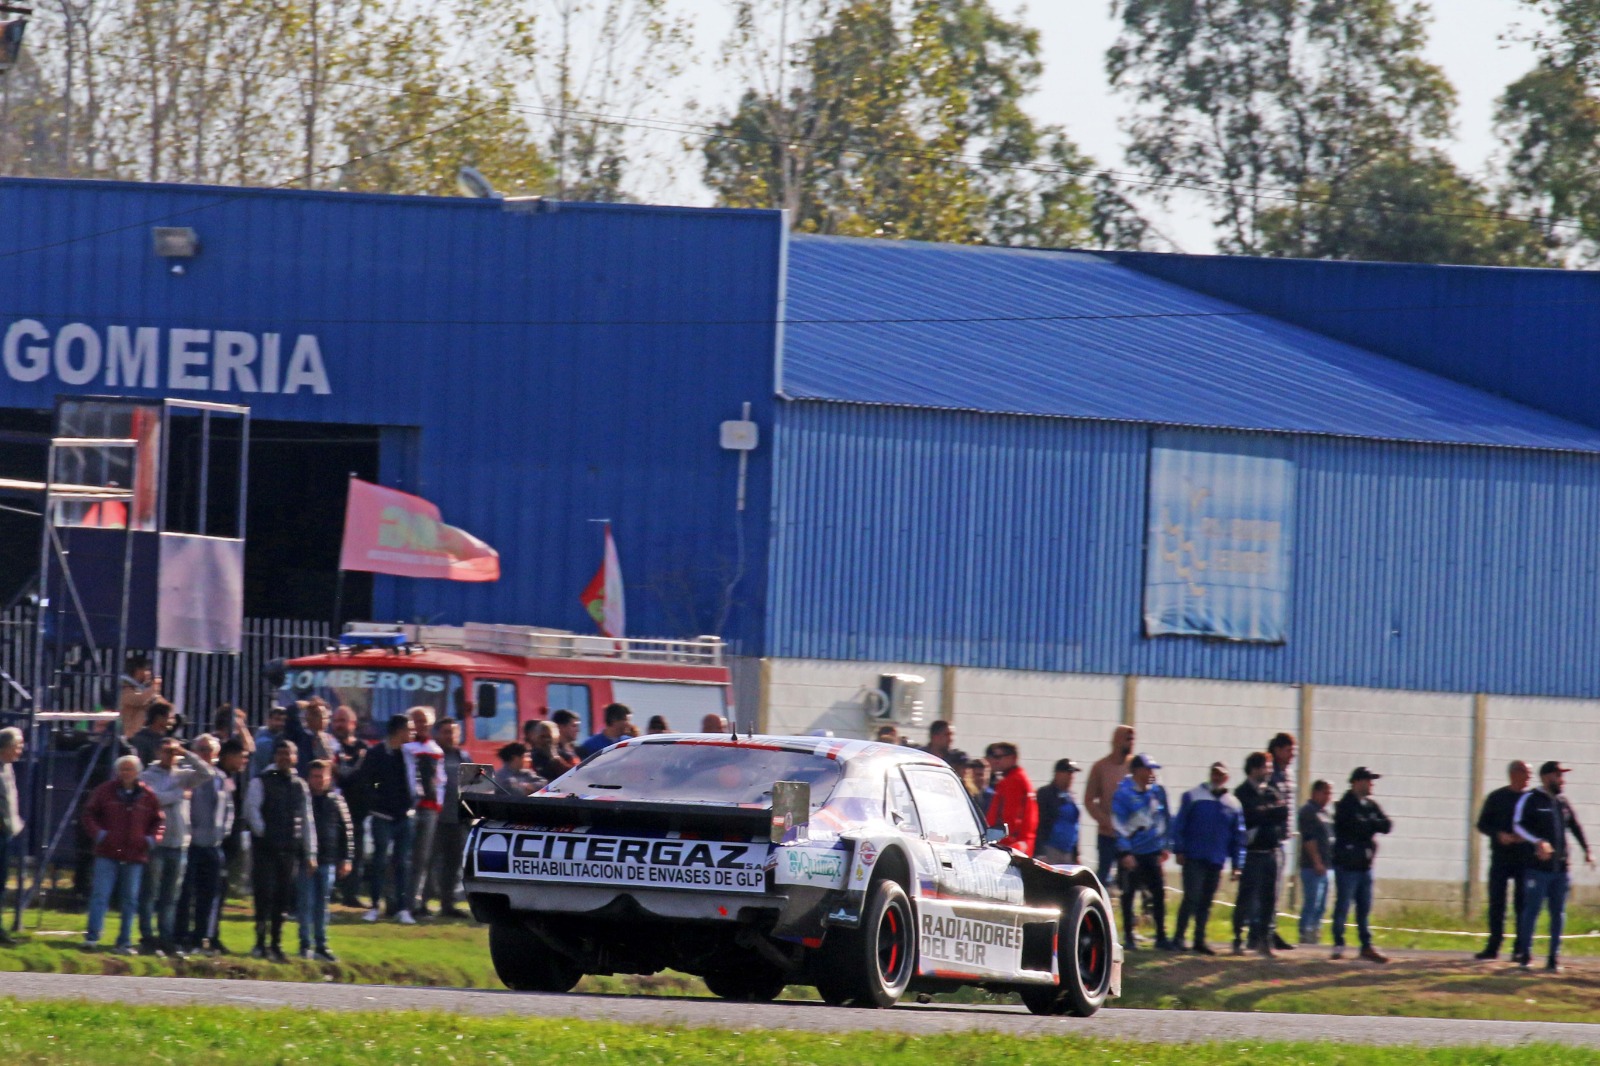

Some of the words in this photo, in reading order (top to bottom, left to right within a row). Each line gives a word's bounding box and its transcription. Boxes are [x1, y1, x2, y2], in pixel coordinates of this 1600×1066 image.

[3, 318, 332, 395] GOMERIA
[512, 833, 749, 870] CITERGAZ
[513, 859, 623, 880] REHABILITACION
[627, 865, 645, 881] DE
[649, 867, 711, 884] ENVASES
[715, 871, 732, 886] DE
[736, 872, 763, 887] GLP
[922, 914, 1021, 949] RADIADORES
[921, 935, 949, 959] DEL
[954, 941, 986, 965] SUR
